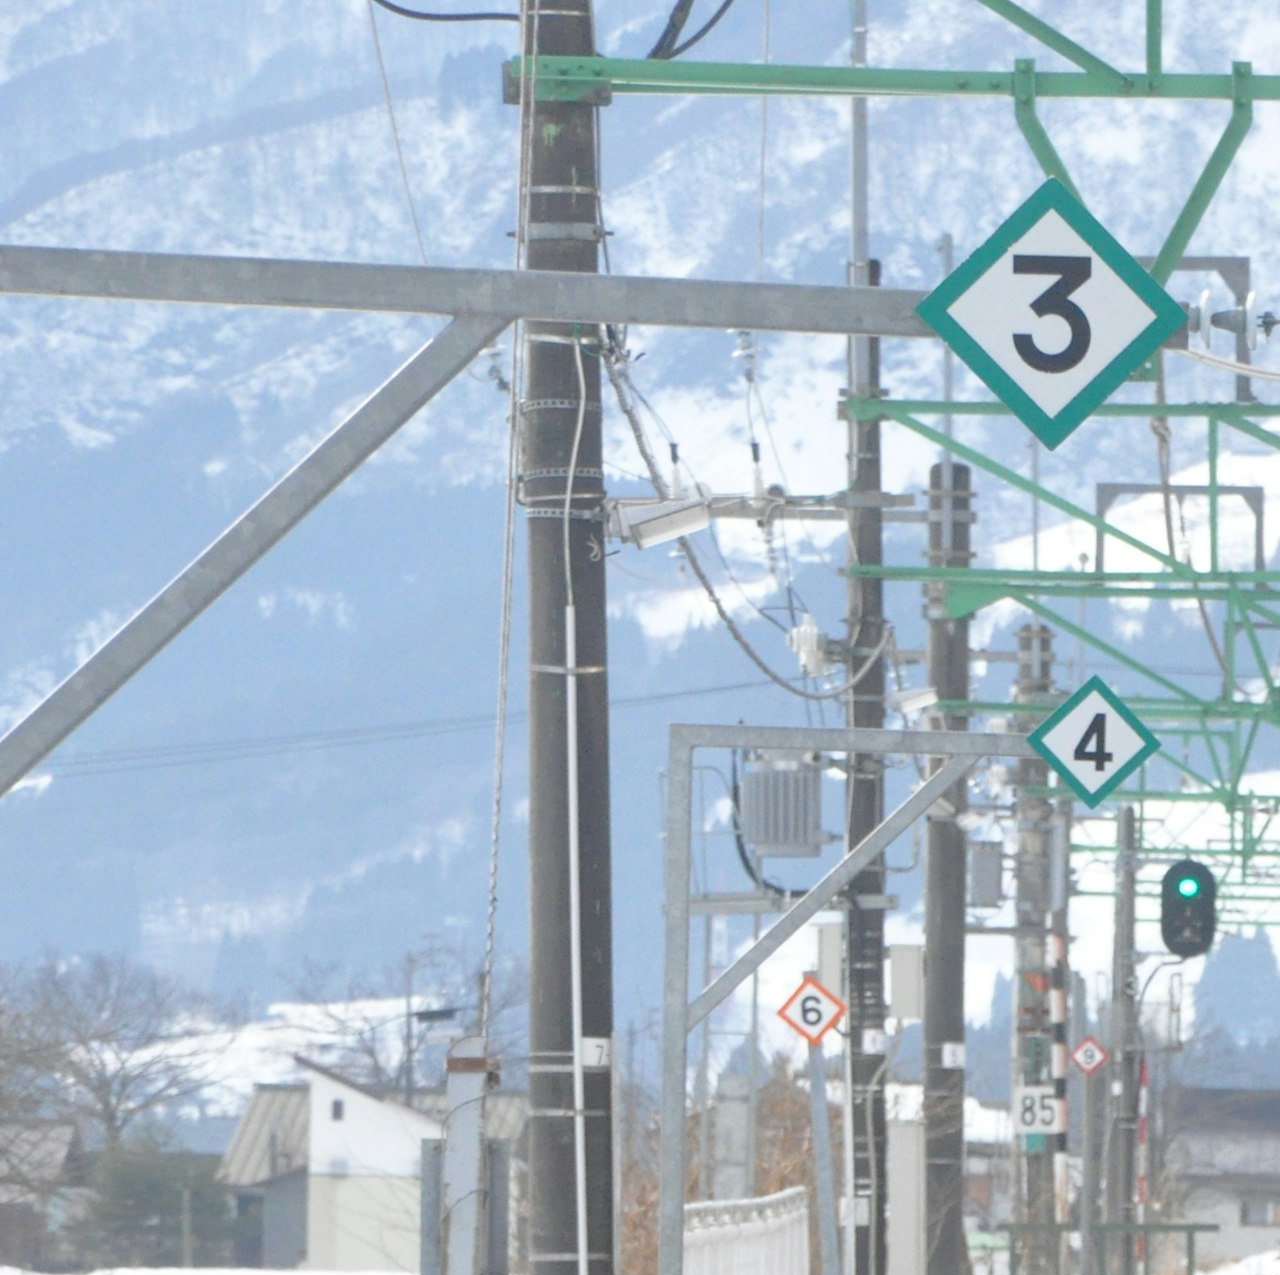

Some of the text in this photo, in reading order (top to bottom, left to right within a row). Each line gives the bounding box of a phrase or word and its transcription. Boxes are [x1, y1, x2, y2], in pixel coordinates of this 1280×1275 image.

[1012, 254, 1092, 374] 3
[1073, 713, 1113, 772] 4
[801, 996, 823, 1026] 6
[1020, 1095, 1056, 1127] 85
